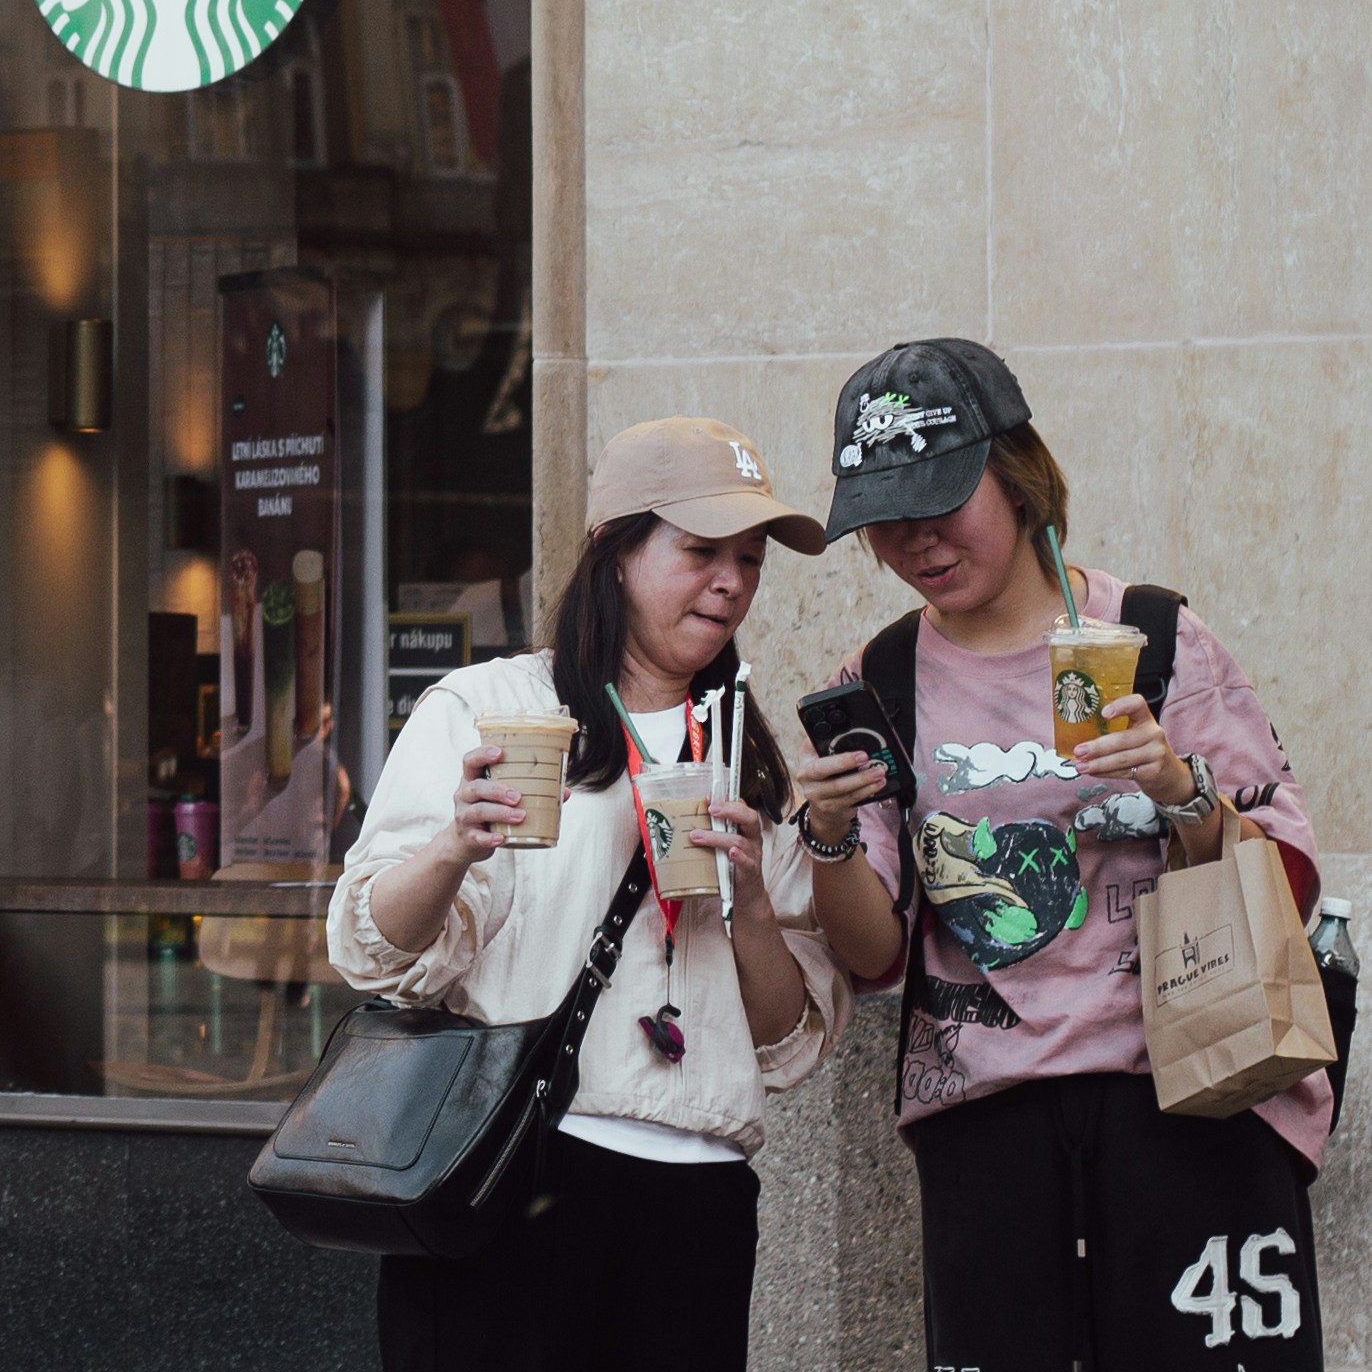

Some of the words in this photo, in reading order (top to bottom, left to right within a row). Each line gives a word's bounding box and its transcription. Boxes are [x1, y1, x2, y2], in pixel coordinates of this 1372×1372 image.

[728, 440, 763, 481] LA
[400, 628, 453, 653] nákupu
[1157, 969, 1200, 996] PRAGUE
